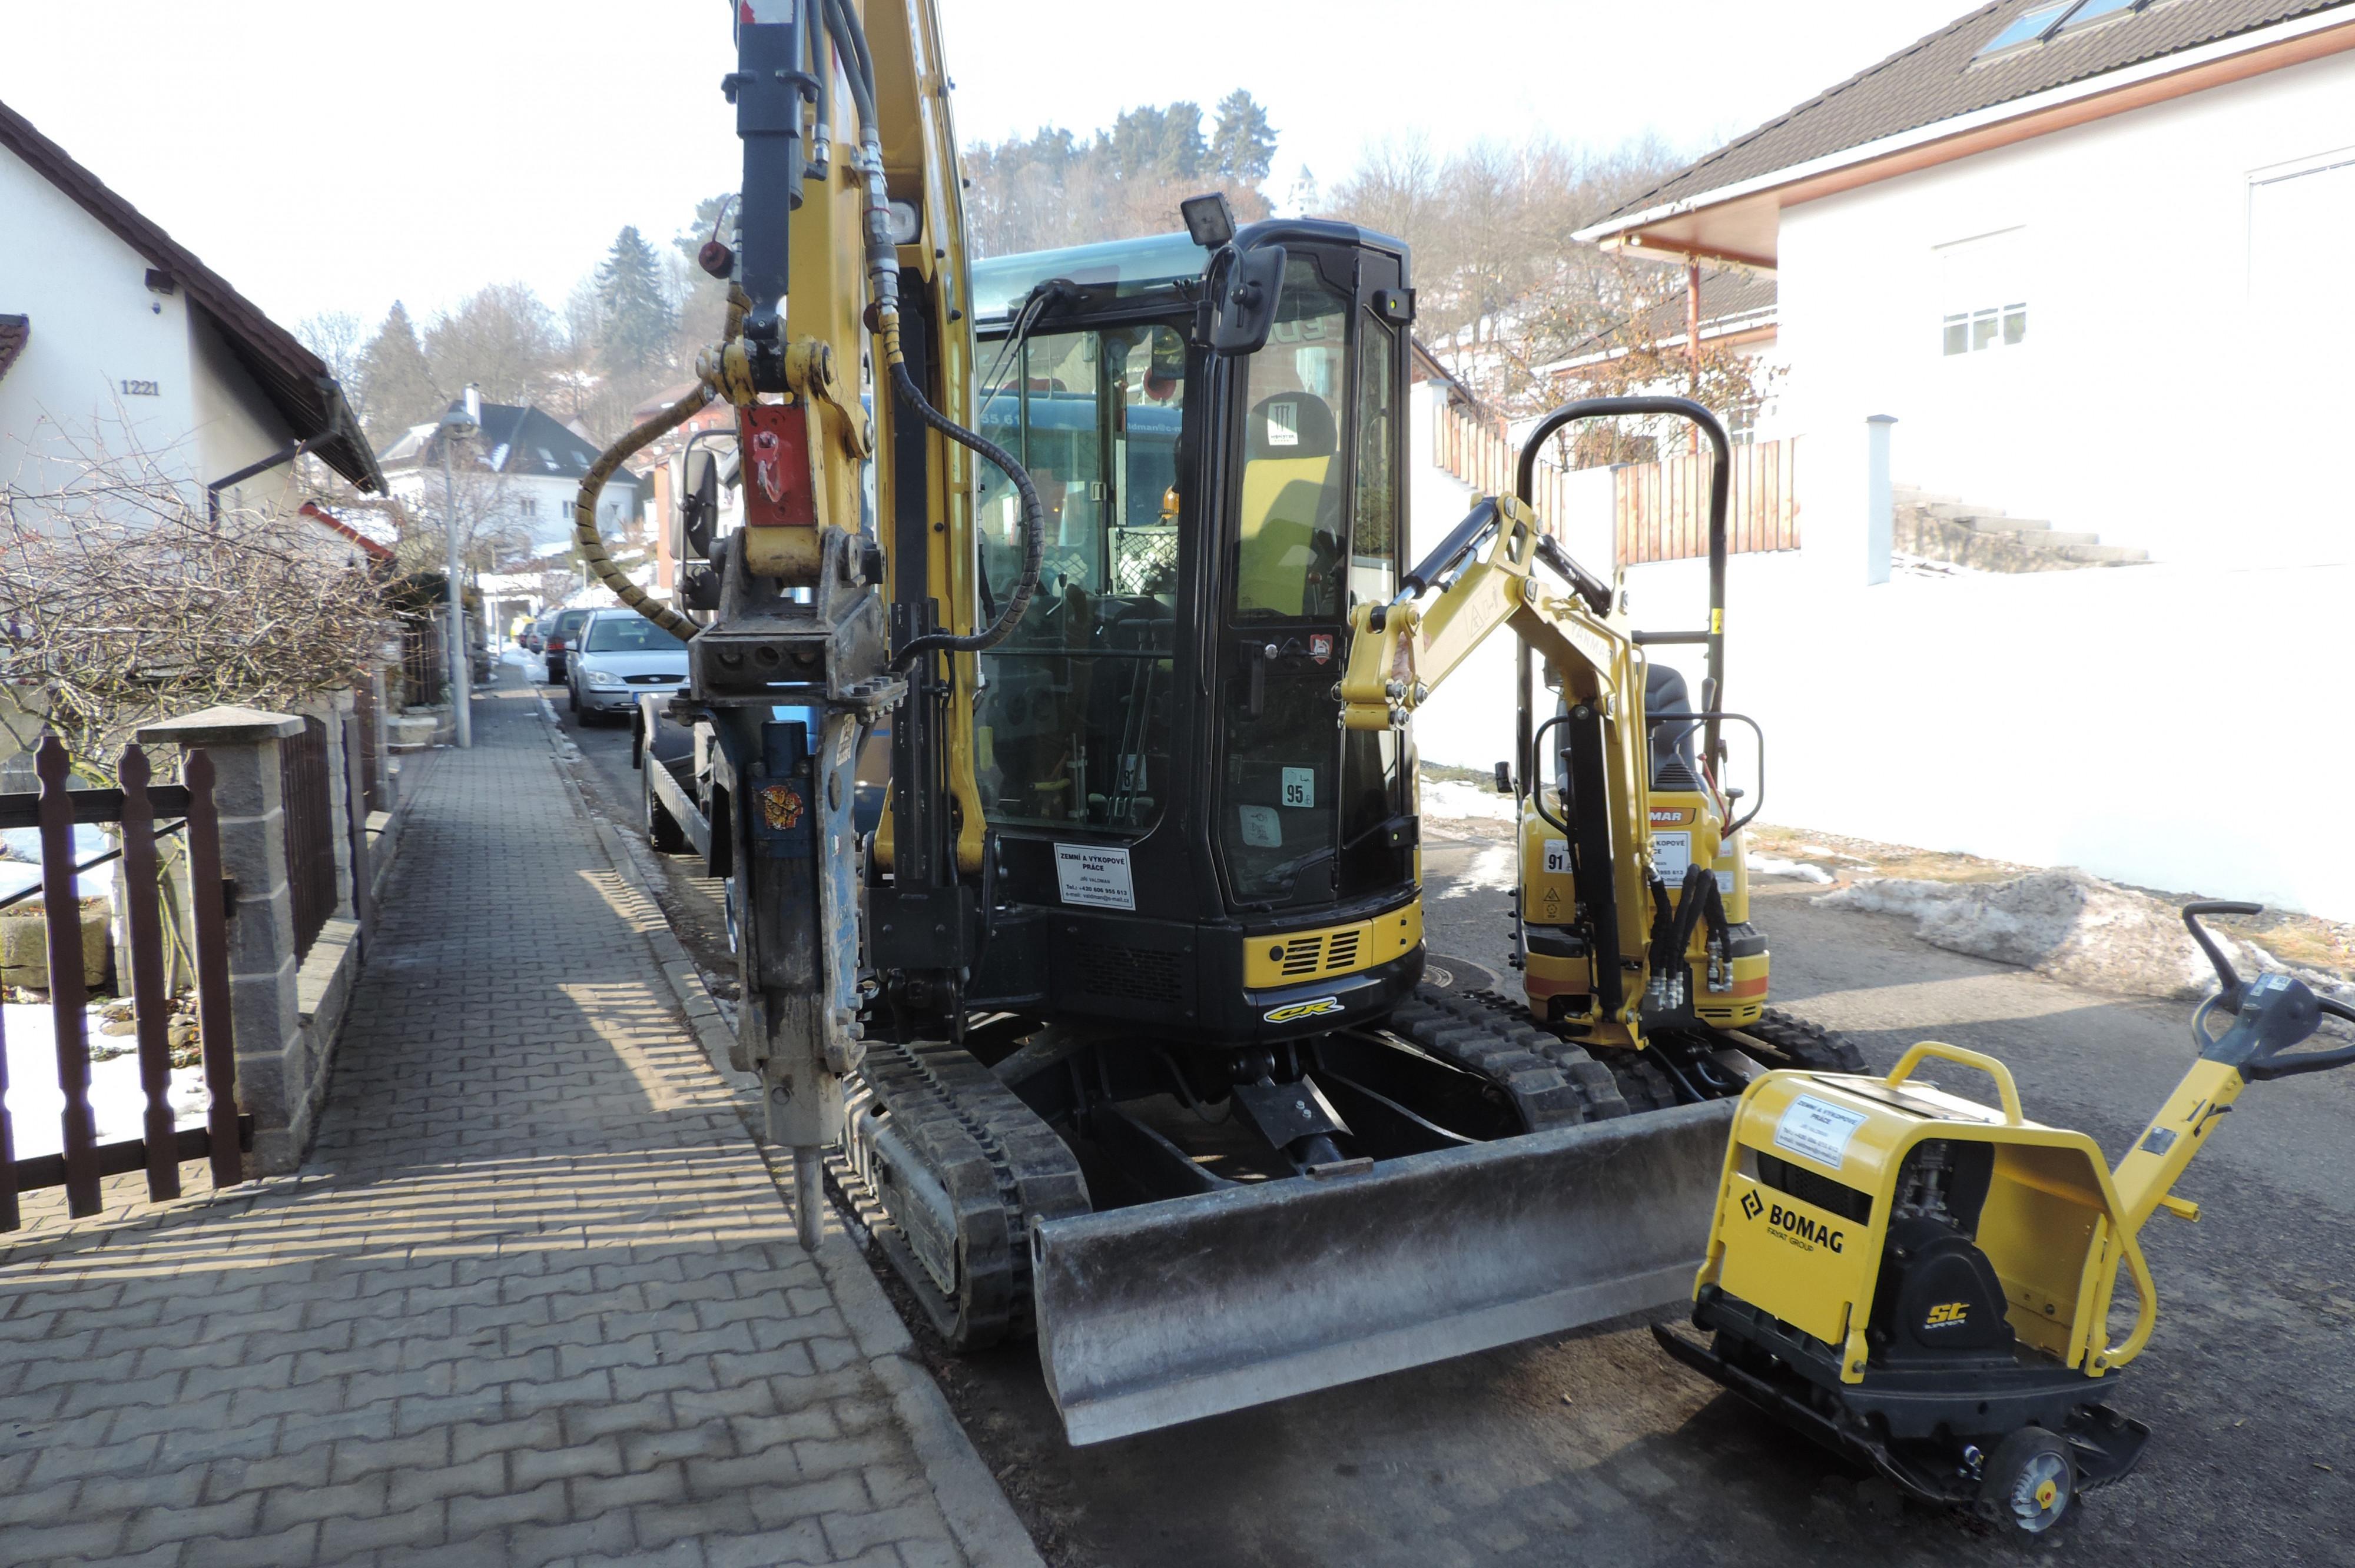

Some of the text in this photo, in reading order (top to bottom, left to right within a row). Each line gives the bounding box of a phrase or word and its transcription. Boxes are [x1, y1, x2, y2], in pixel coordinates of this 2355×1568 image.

[121, 380, 160, 396] 1221
[980, 414, 1032, 425] 55 61
[1127, 423, 1182, 431] ldman@c-m
[1287, 785, 1303, 803] 95
[1649, 812, 1682, 820] MAR
[1083, 863, 1104, 871] PRÁCE
[1089, 855, 1125, 865] VÝKOPOVÉ
[1548, 854, 1563, 870] 91
[1266, 999, 1339, 1022] CR
[1770, 1204, 1844, 1254] BOMAG
[1767, 1227, 1814, 1252] FAYAT GROUP
